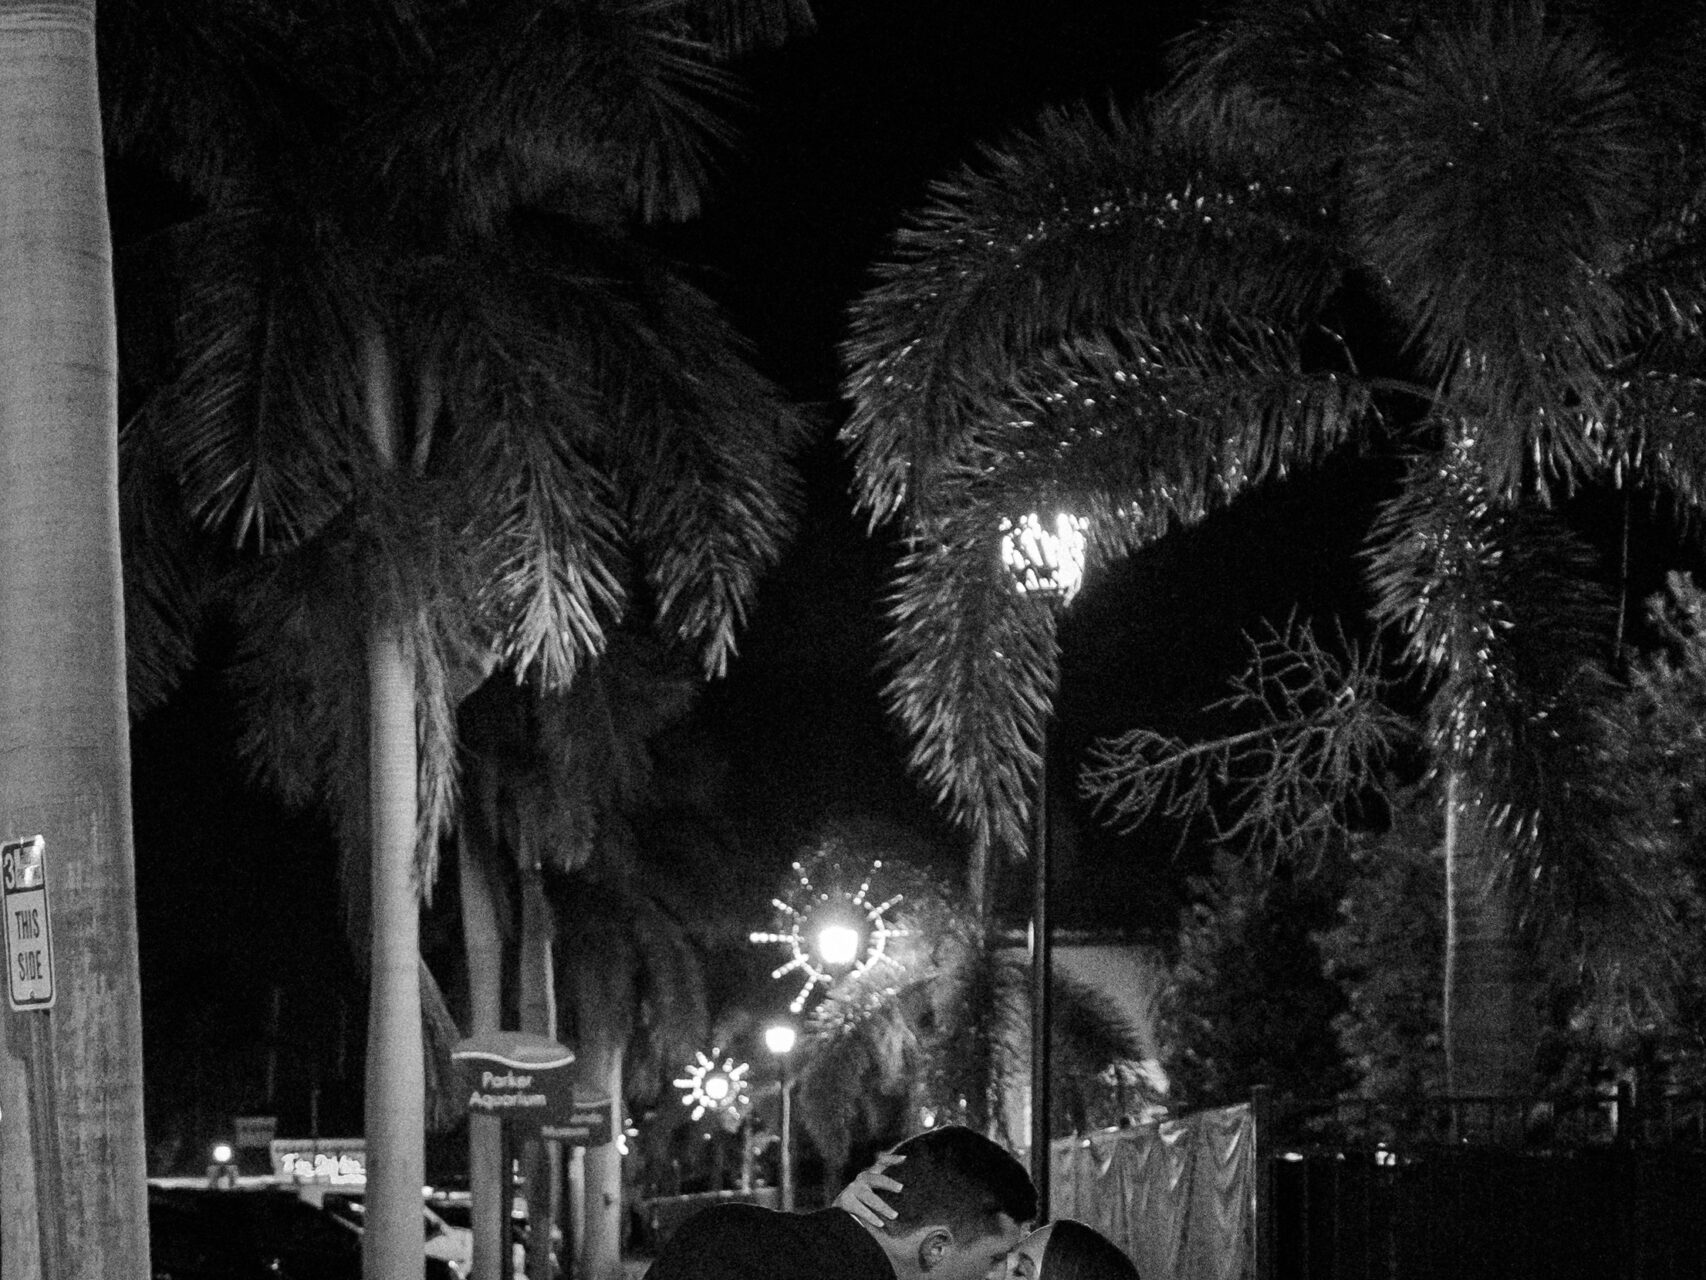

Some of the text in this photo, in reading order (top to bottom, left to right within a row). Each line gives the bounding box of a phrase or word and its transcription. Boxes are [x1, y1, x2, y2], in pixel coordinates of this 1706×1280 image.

[3, 853, 15, 889] 3
[15, 908, 40, 940] THIS
[18, 950, 43, 982] SIDE
[482, 1070, 533, 1089] Parker
[469, 1090, 547, 1110] Aquarium
